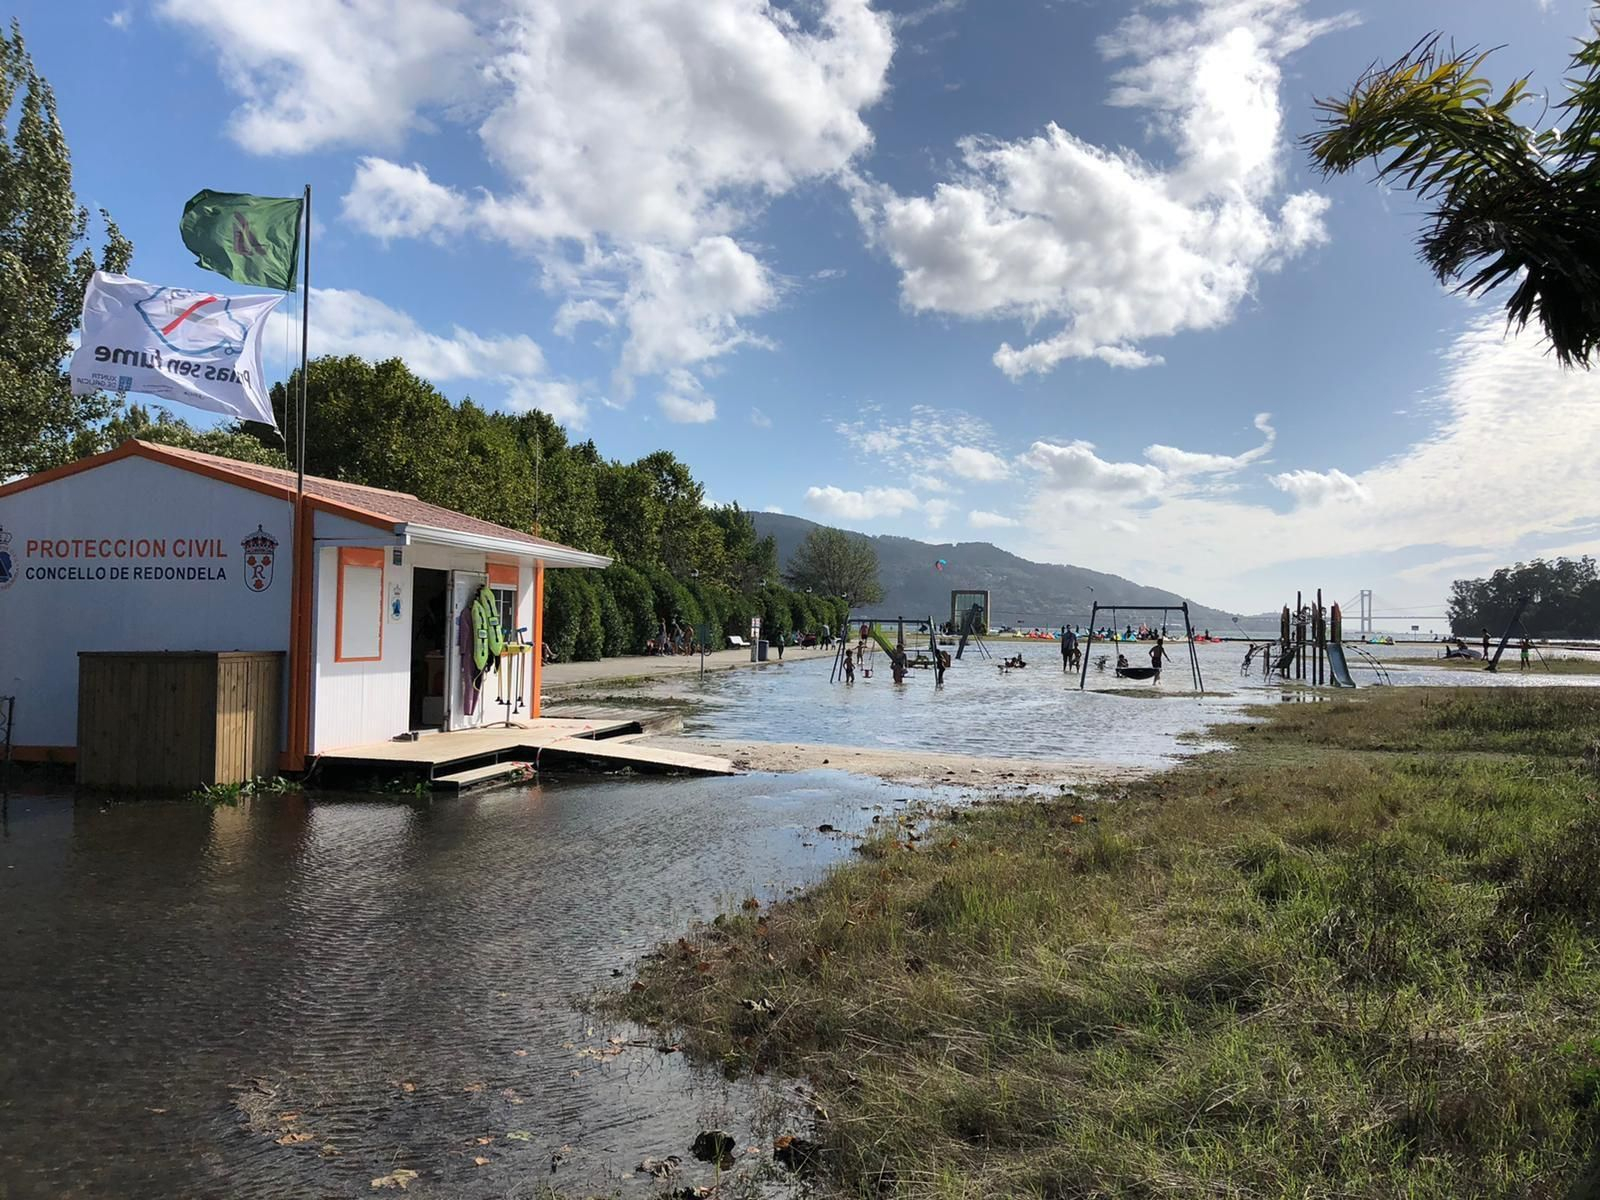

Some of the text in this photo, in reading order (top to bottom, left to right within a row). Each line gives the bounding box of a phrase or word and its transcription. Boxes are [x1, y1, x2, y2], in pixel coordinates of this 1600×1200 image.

[26, 539, 228, 558] PROTECCION CIVIL
[25, 566, 227, 580] CONCELLO DE REDONDELA
